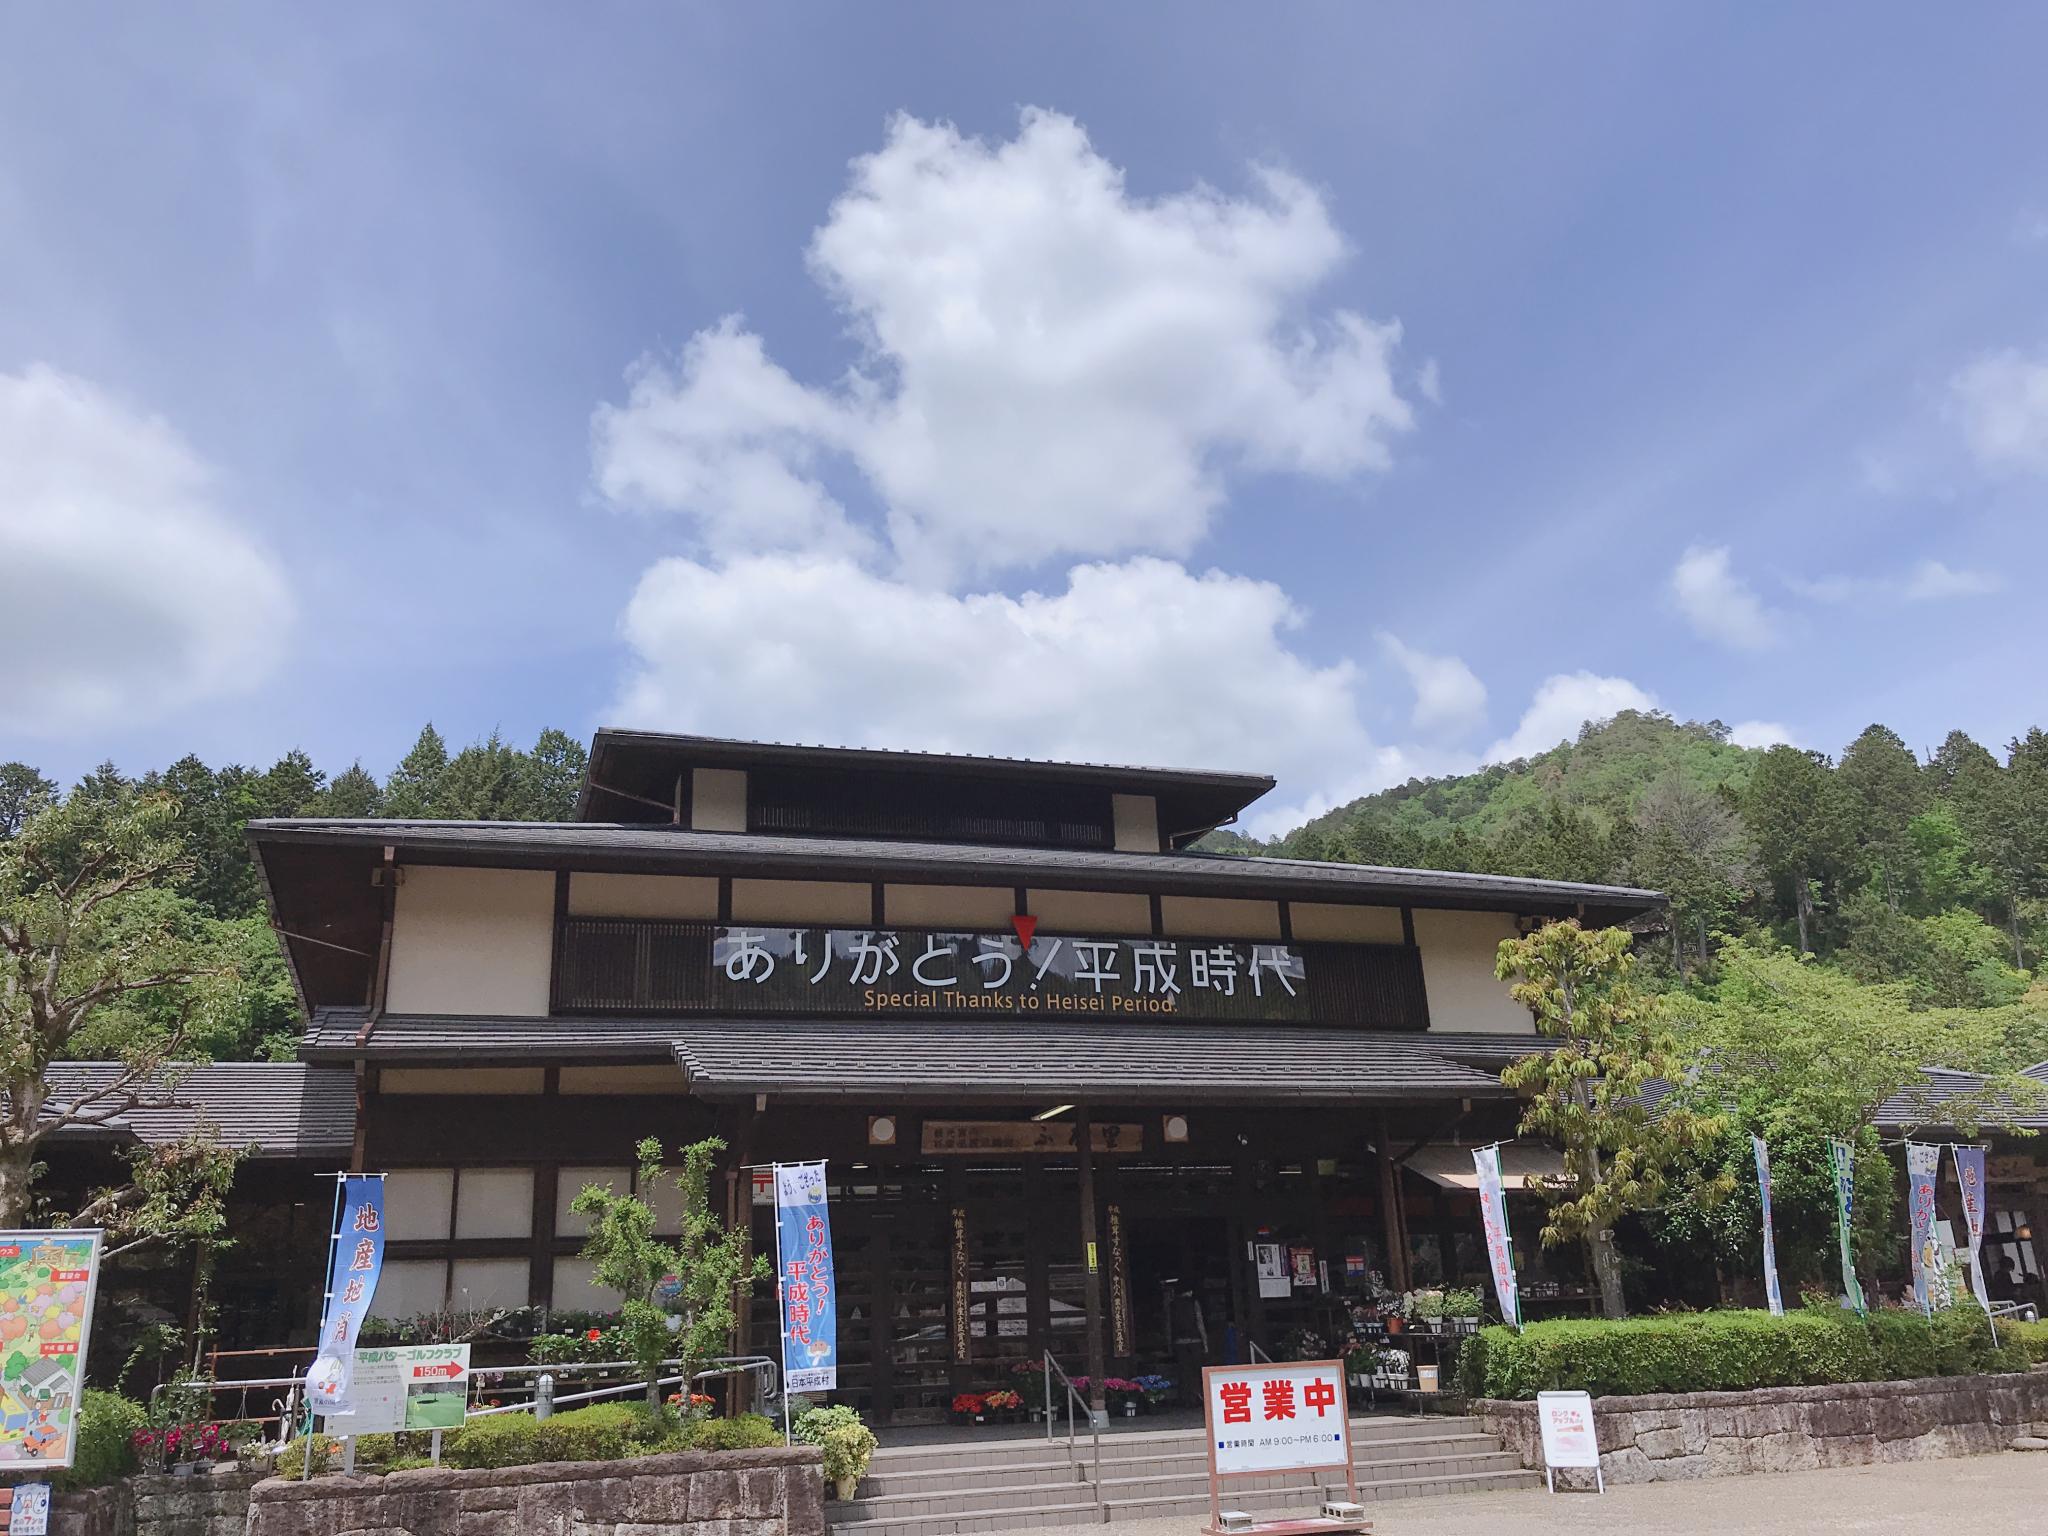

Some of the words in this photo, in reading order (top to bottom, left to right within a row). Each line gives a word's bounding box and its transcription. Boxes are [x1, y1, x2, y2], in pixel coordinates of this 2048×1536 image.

[724, 931, 1297, 997] ありがとう！平成時代
[864, 989, 937, 1009] Special
[943, 991, 1013, 1010] Thanks
[1020, 995, 1039, 1010] to
[1046, 992, 1105, 1011] Heisei
[1111, 995, 1178, 1013] Period.
[806, 1215, 829, 1314] ありがとう！
[787, 1262, 811, 1345] 平成時代
[358, 1347, 463, 1364] 平成パターゴルフクラブ
[419, 1366, 447, 1377] 150m
[792, 1376, 829, 1388] 日本平成村
[1220, 1377, 1336, 1424] 営業中
[1226, 1439, 1255, 1449] 営業時間
